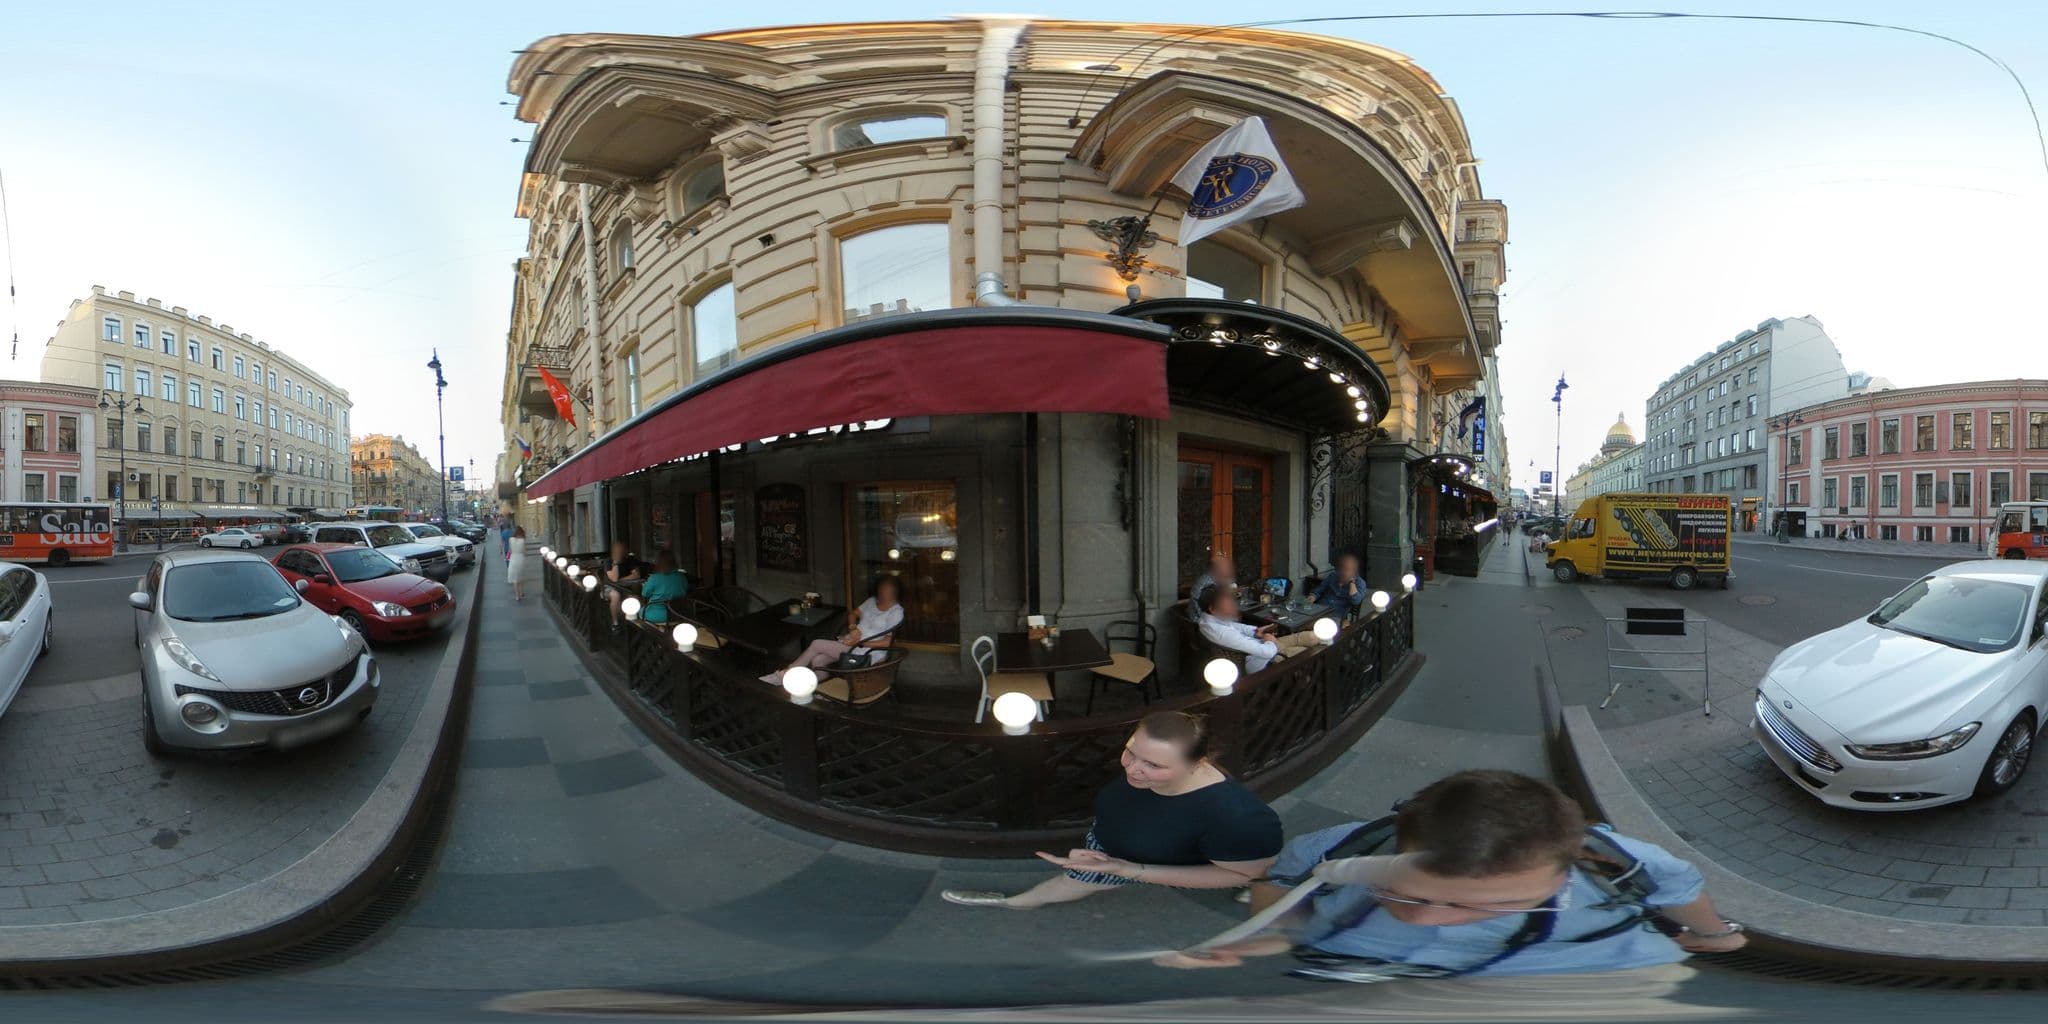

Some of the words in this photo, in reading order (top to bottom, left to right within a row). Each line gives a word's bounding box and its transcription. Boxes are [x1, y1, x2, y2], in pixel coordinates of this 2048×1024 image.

[1238, 157, 1272, 175] HOTEL
[1678, 497, 1728, 509] ШИНЫ
[41, 514, 110, 545] Sale
